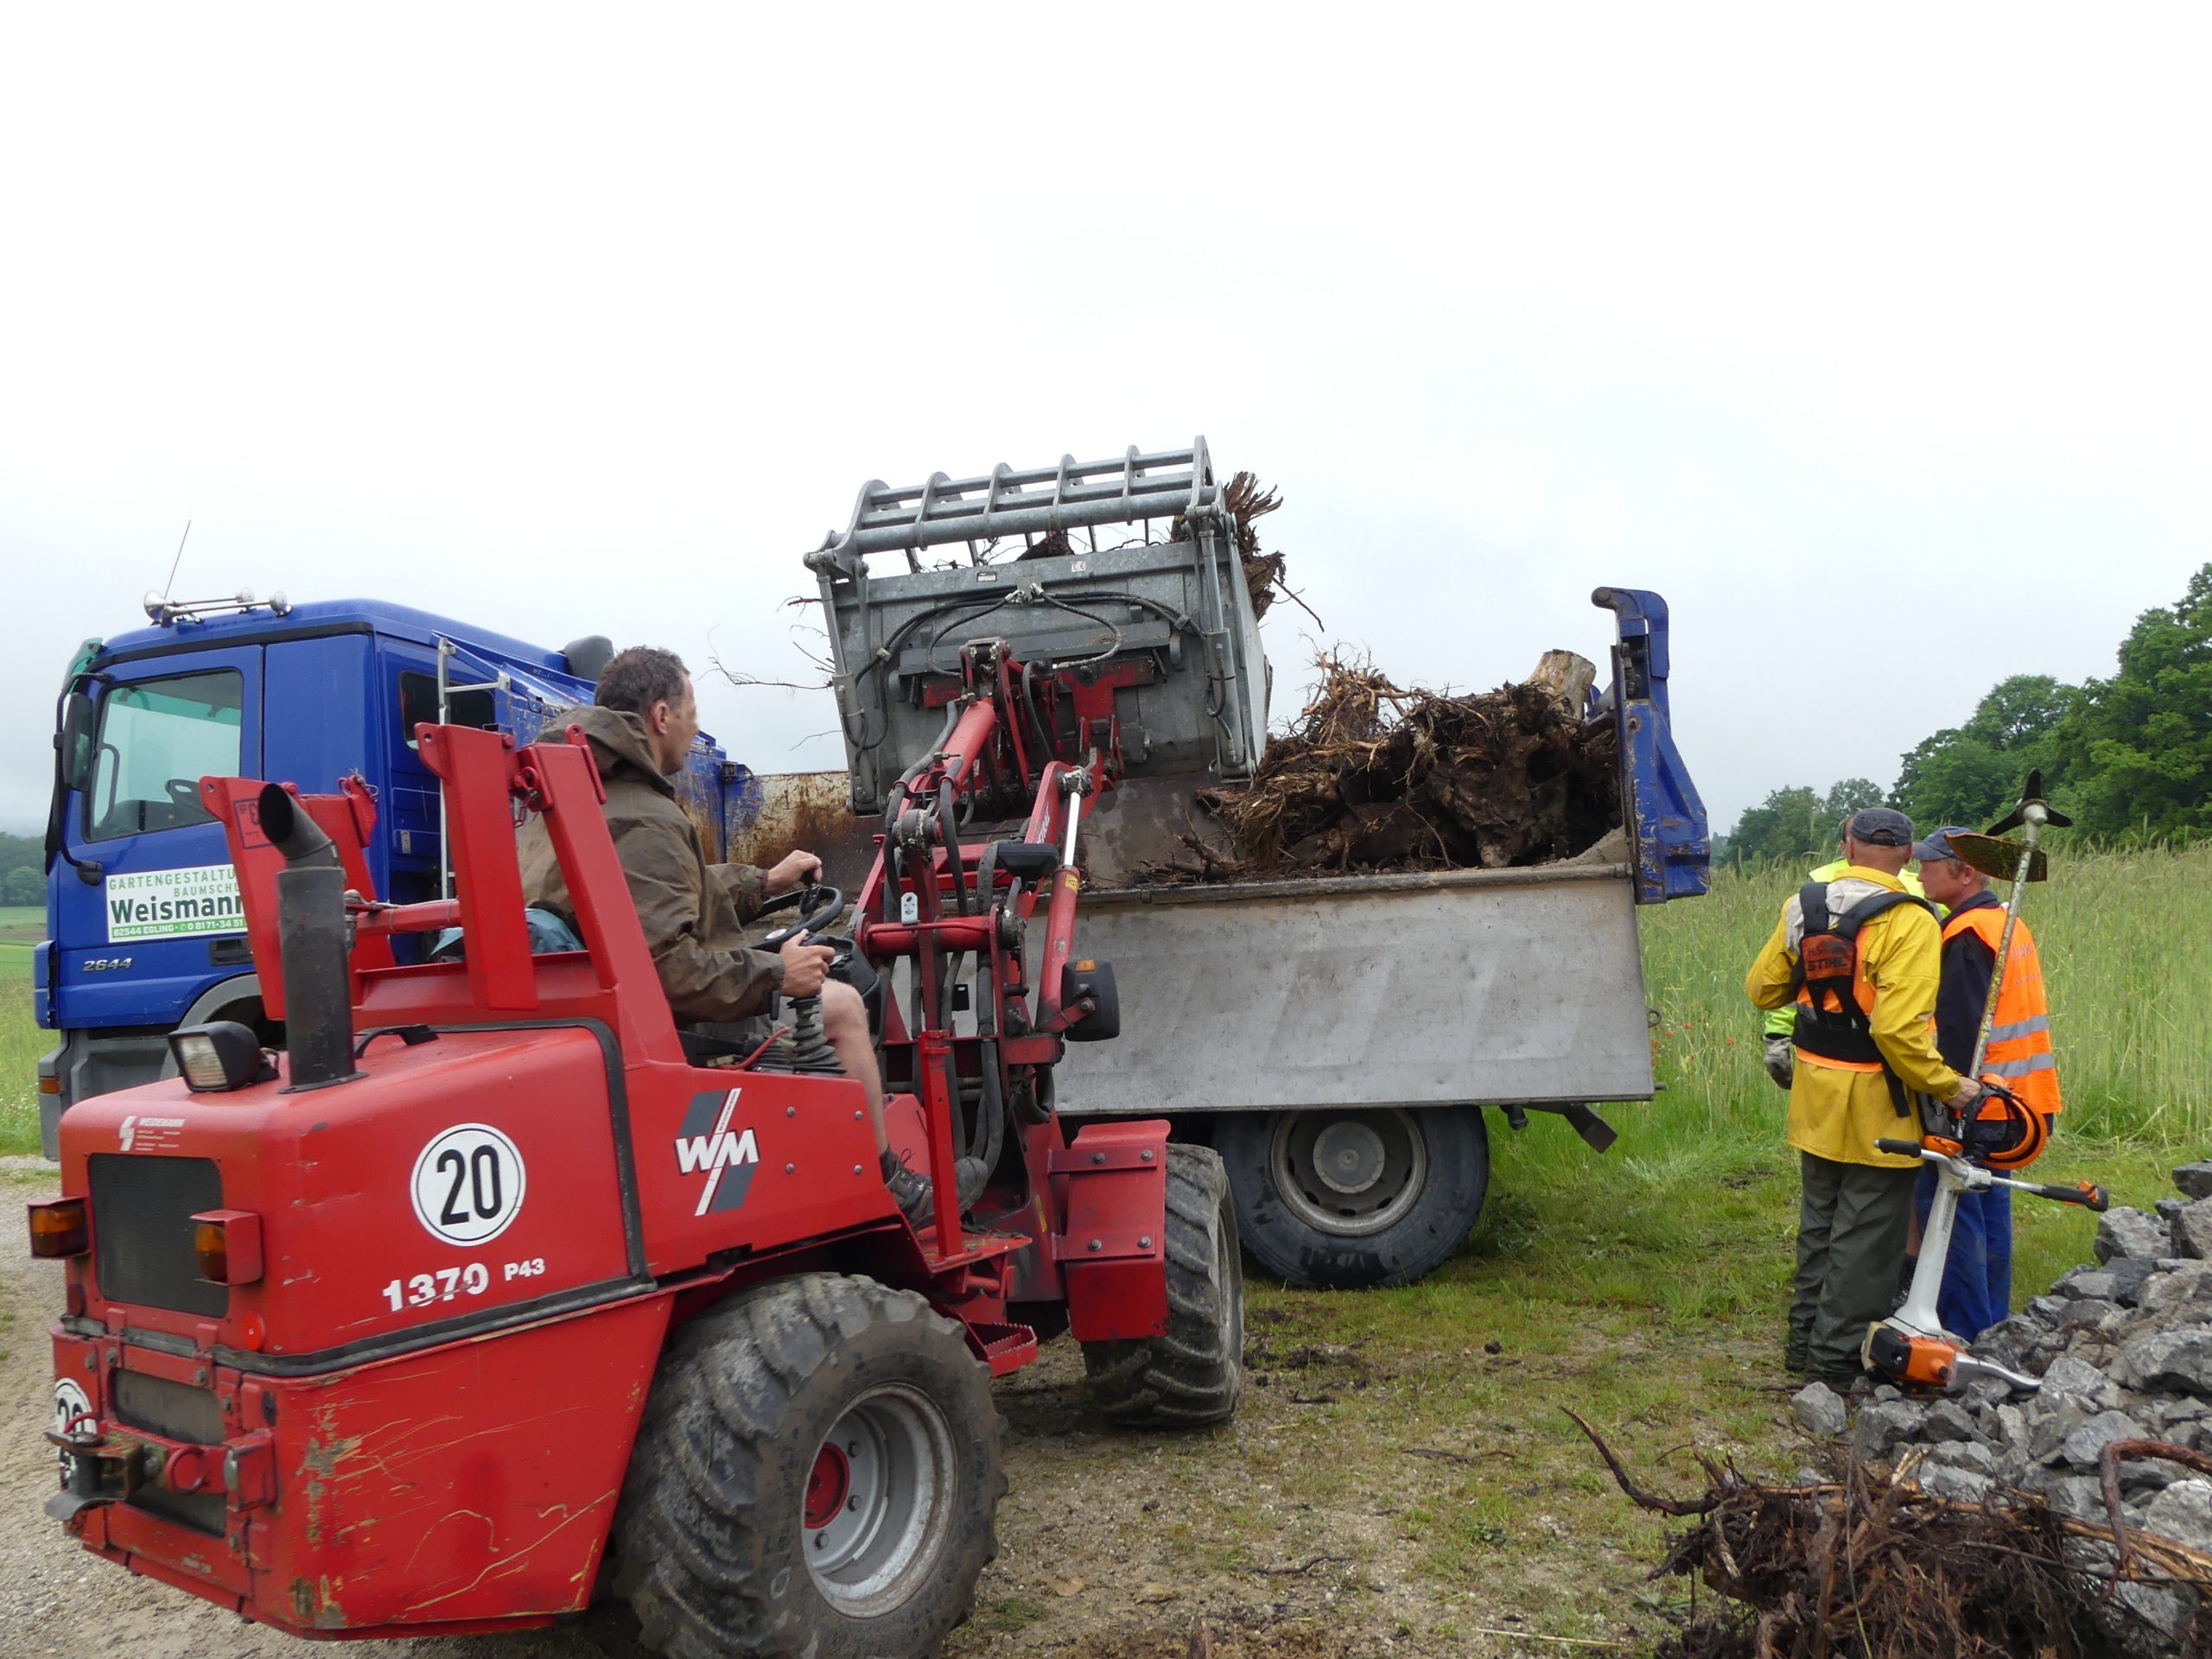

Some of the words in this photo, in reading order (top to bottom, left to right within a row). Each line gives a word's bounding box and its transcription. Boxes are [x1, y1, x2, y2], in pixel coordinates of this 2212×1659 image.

[113, 927, 142, 937] 82544
[83, 957, 132, 972] 2644
[436, 1144, 503, 1226] 20
[383, 1262, 489, 1313] 1370
[504, 1258, 546, 1281] P43
